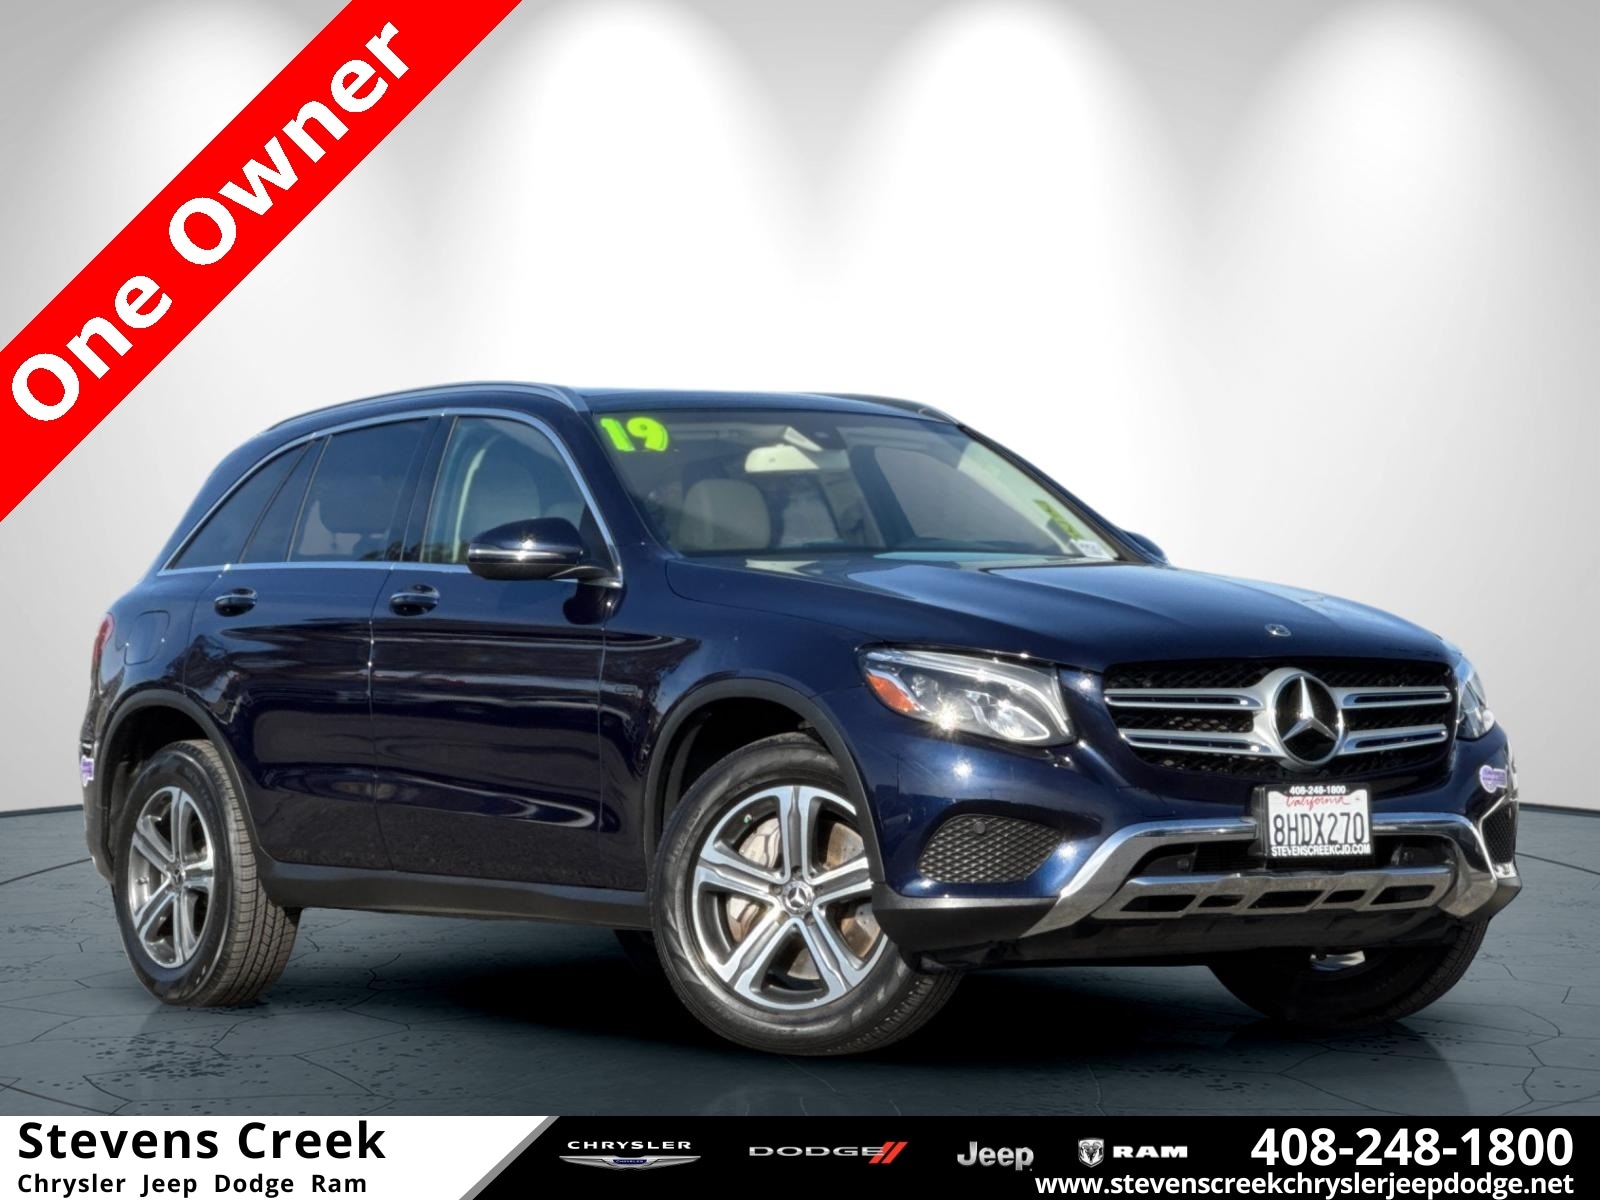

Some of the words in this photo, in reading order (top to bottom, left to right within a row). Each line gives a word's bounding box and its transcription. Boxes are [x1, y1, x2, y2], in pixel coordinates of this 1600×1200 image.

[600, 416, 668, 452] 19
[1289, 786, 1347, 795] 408-248-1800
[1285, 796, 1350, 811] California
[1273, 812, 1365, 846] 8HDX270
[1271, 844, 1371, 857] STEVENSCREEKCJD.COM
